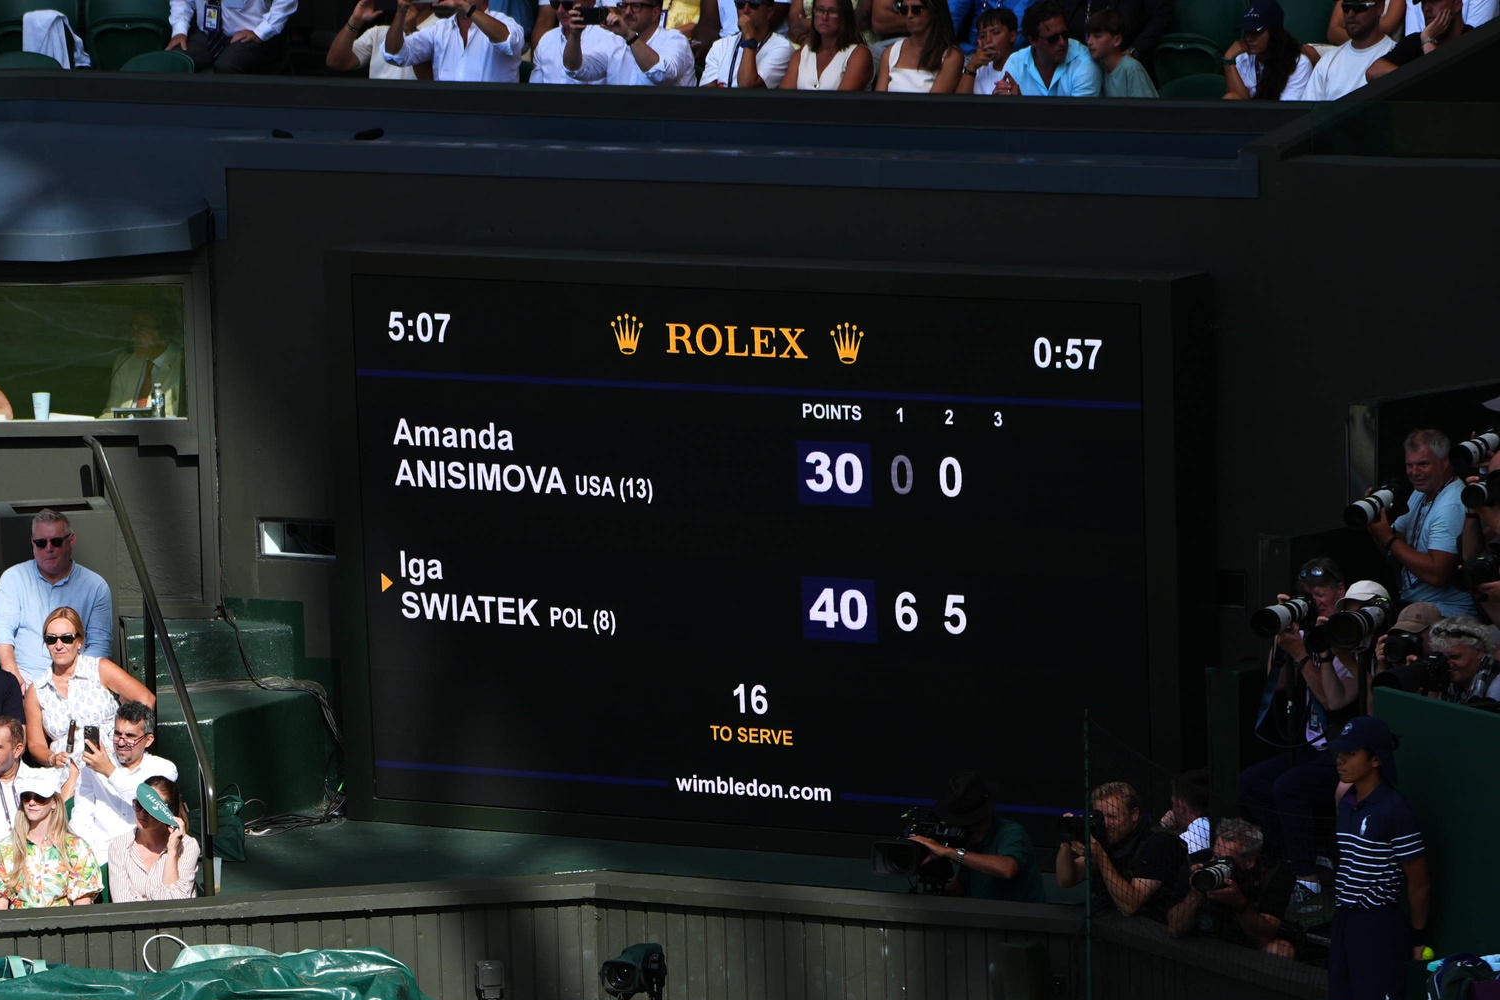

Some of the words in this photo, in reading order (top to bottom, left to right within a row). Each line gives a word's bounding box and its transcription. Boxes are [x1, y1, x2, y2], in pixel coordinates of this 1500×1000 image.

[388, 311, 451, 343] 5:07
[665, 323, 809, 359] ROLEX
[1033, 336, 1103, 370] 0:57
[802, 402, 862, 421] POINTS
[896, 407, 904, 423] 1
[944, 409, 954, 425] 2
[993, 411, 1003, 427] 3
[392, 417, 514, 451] Amanda
[394, 458, 567, 495] ANISIMOVA
[575, 474, 616, 498] USA
[619, 476, 654, 505] (13)
[805, 450, 864, 495] 30
[891, 455, 913, 494] 0
[938, 456, 963, 498] 0
[399, 550, 444, 586] Iga
[401, 590, 541, 627] SWIATEK
[549, 606, 589, 630] POL
[592, 609, 617, 636] (8)
[808, 587, 868, 631] 40
[894, 591, 919, 632] 6
[943, 594, 967, 635] 5
[732, 683, 769, 715] 16
[709, 725, 733, 742] TO
[737, 726, 794, 746] SERVE
[675, 773, 832, 802] wimbledon.com
